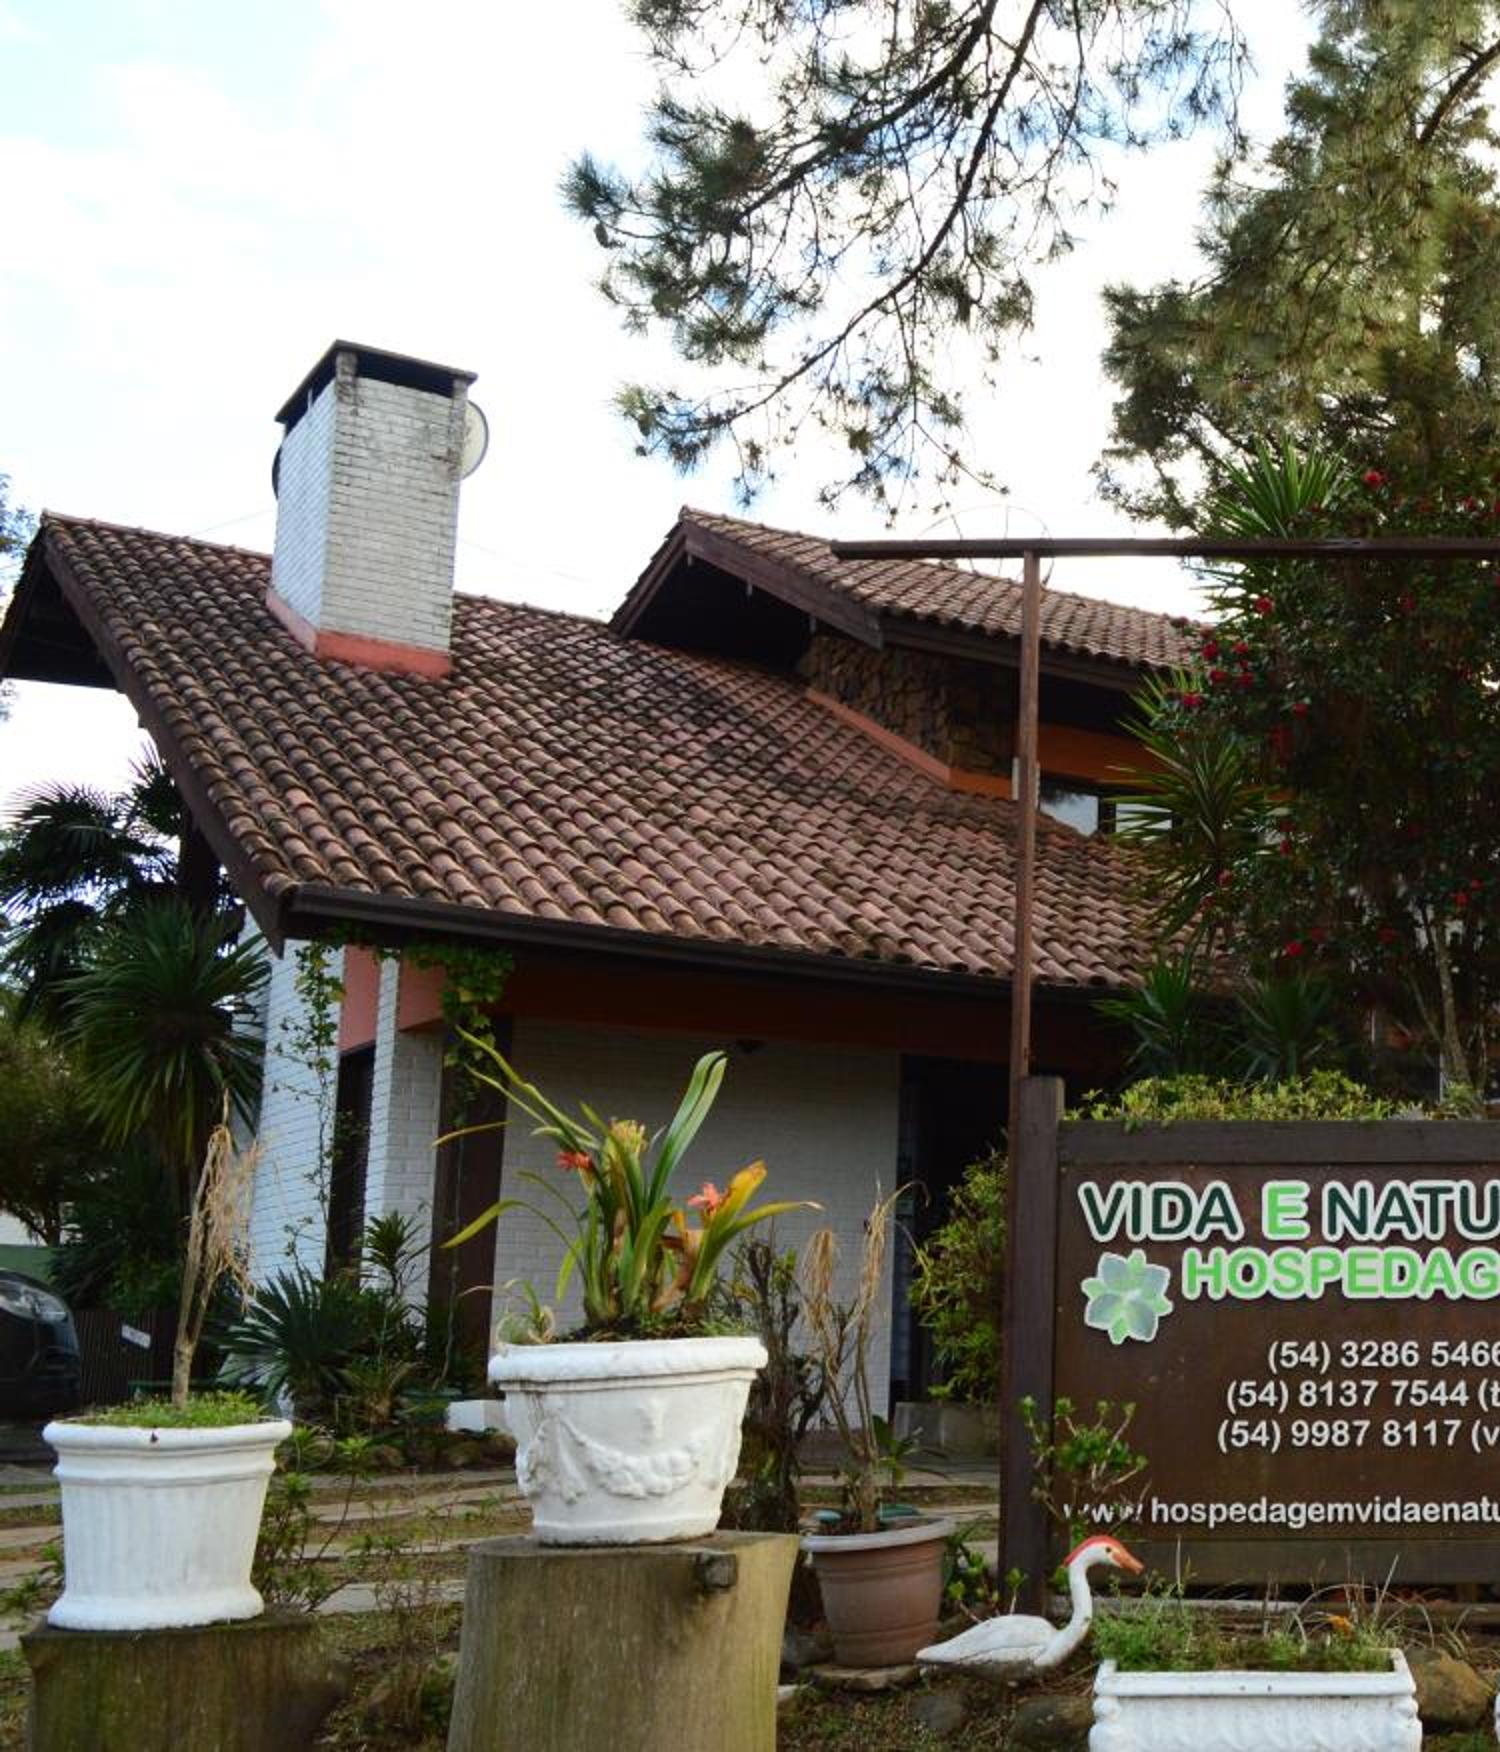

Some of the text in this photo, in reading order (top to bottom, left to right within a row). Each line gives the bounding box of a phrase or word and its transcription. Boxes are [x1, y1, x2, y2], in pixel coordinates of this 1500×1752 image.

[1078, 1181, 1244, 1241] VIDA
[1262, 1180, 1310, 1240] E
[1268, 1340, 1331, 1374] (54)
[1340, 1340, 1419, 1368] 3286
[1227, 1380, 1289, 1414] (54)
[1299, 1380, 1378, 1407] 8137
[1391, 1380, 1469, 1407] 7544
[1218, 1419, 1281, 1453] (54)
[1291, 1419, 1370, 1447] 9987
[1383, 1419, 1462, 1447] 8117
